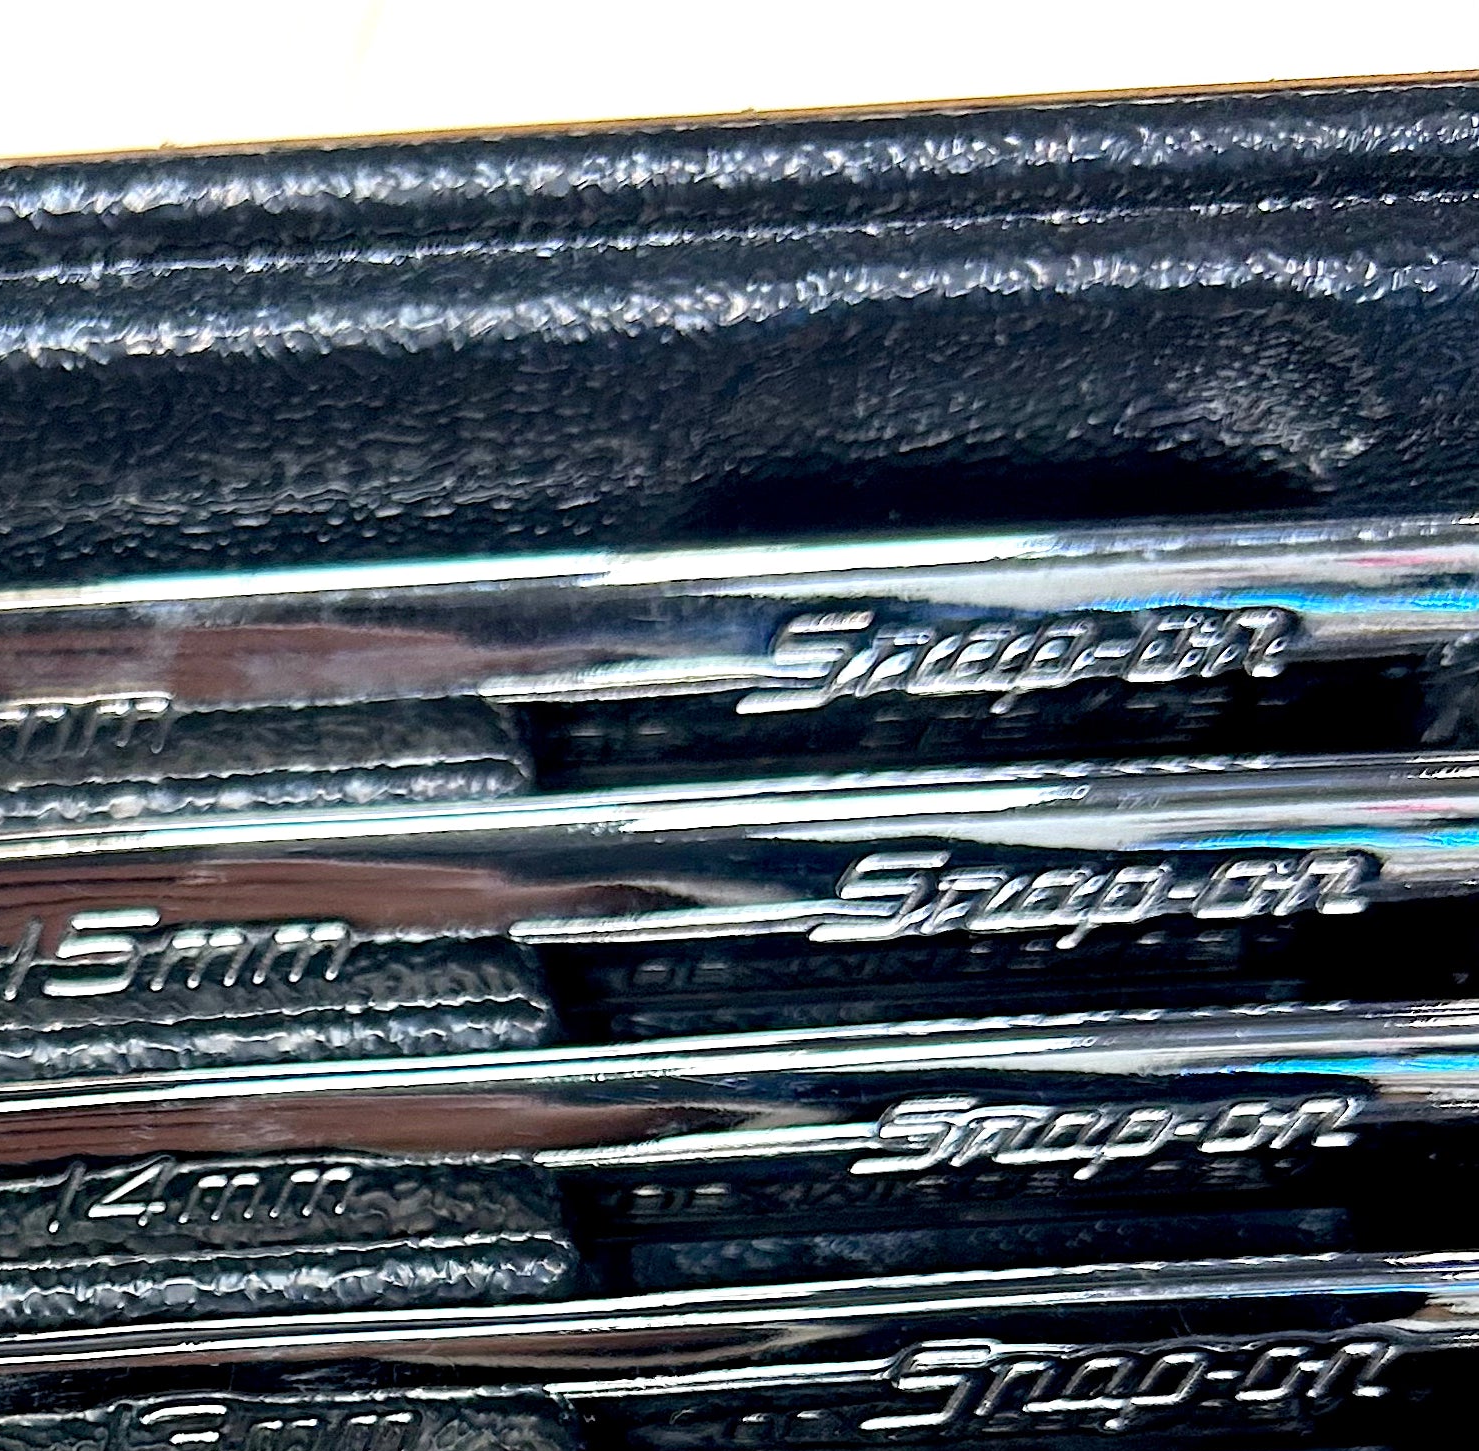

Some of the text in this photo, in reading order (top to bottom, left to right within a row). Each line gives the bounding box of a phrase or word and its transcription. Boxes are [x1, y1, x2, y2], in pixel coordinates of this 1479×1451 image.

[735, 606, 1301, 716] Snap-on
[807, 848, 1379, 950] Snap-on
[2, 905, 351, 1001] 15mm
[849, 1093, 1363, 1182] Snap-on
[47, 1157, 355, 1234] 14mm
[859, 1338, 1397, 1432] Snap-on
